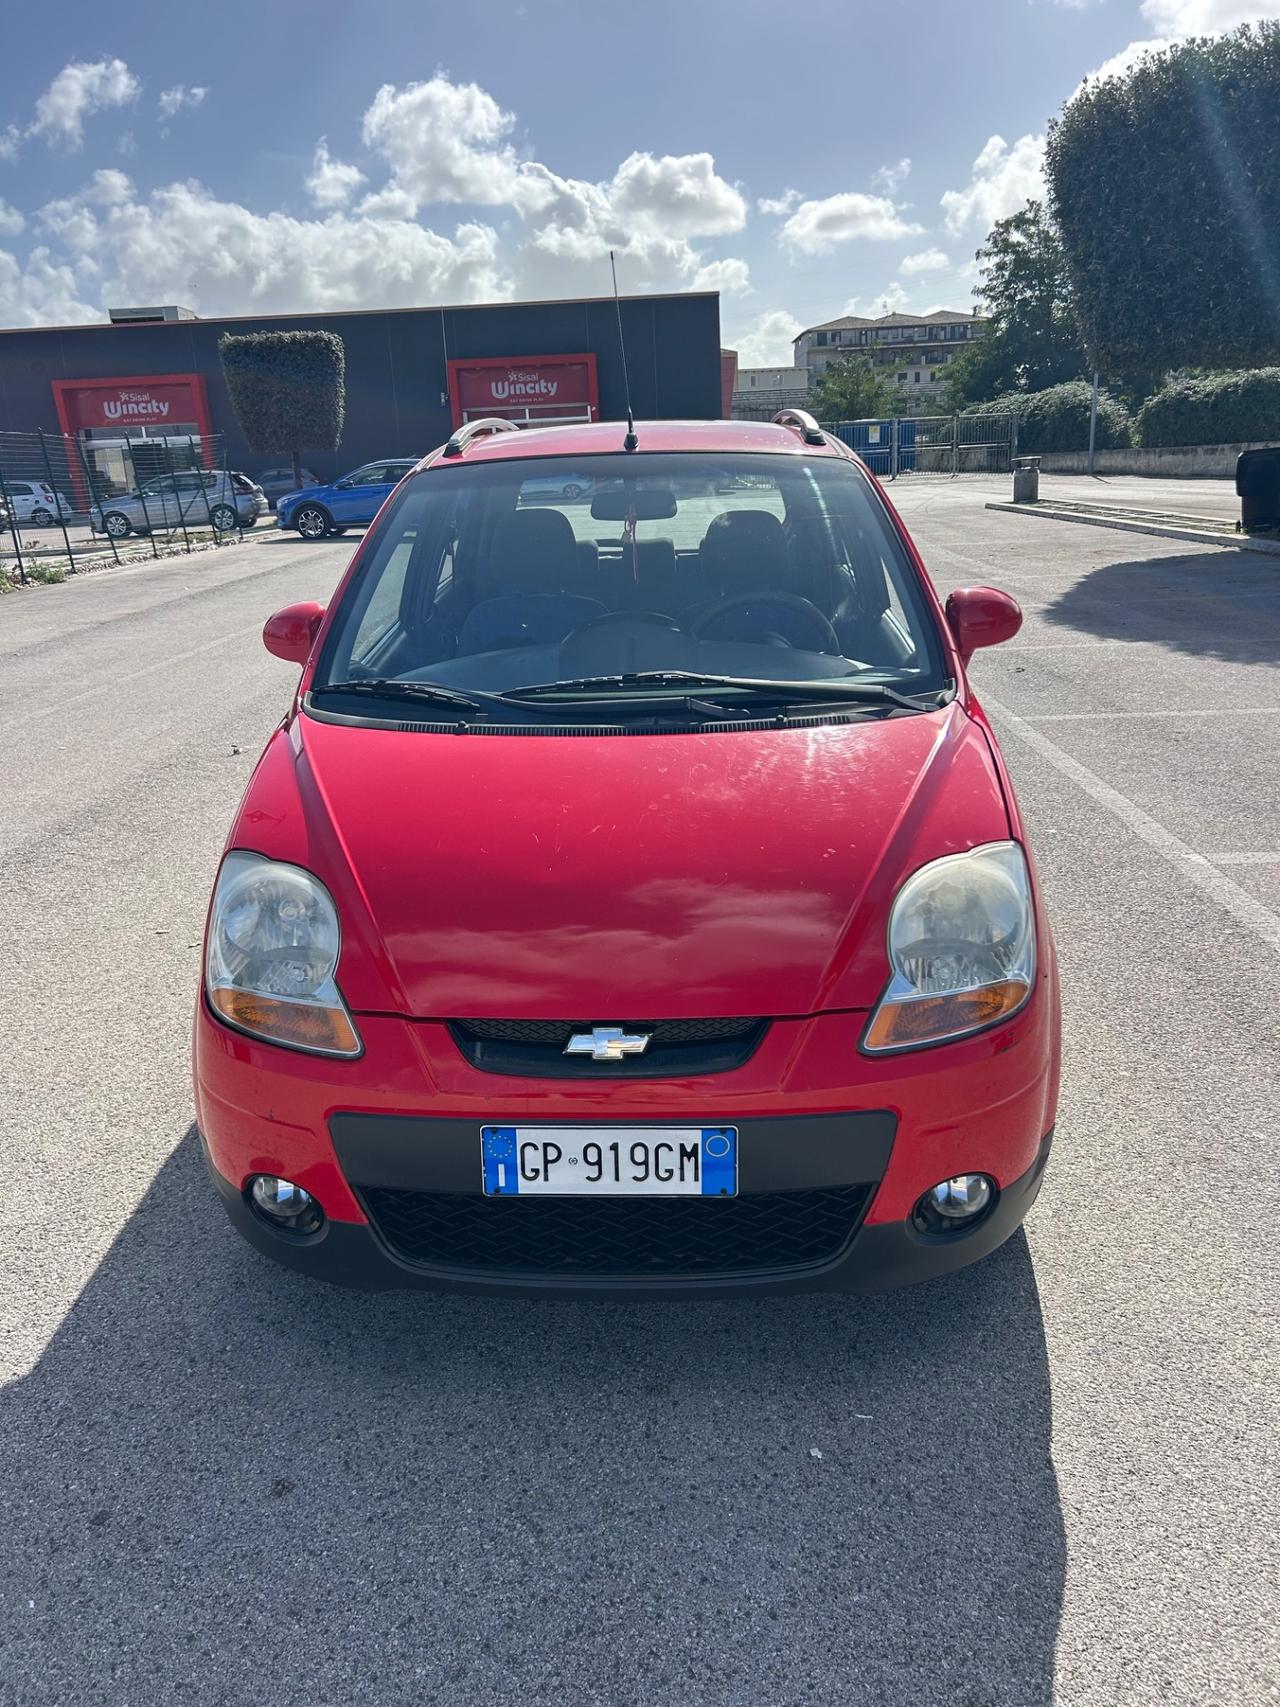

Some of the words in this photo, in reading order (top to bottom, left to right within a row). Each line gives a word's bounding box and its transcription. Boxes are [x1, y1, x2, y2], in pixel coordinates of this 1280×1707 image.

[518, 372, 538, 382] Sisal
[130, 392, 150, 401] Sisal
[491, 380, 557, 399] Wincity
[103, 400, 169, 418] Wincity
[520, 1142, 562, 1182] GP
[582, 1142, 699, 1182] 919GM
